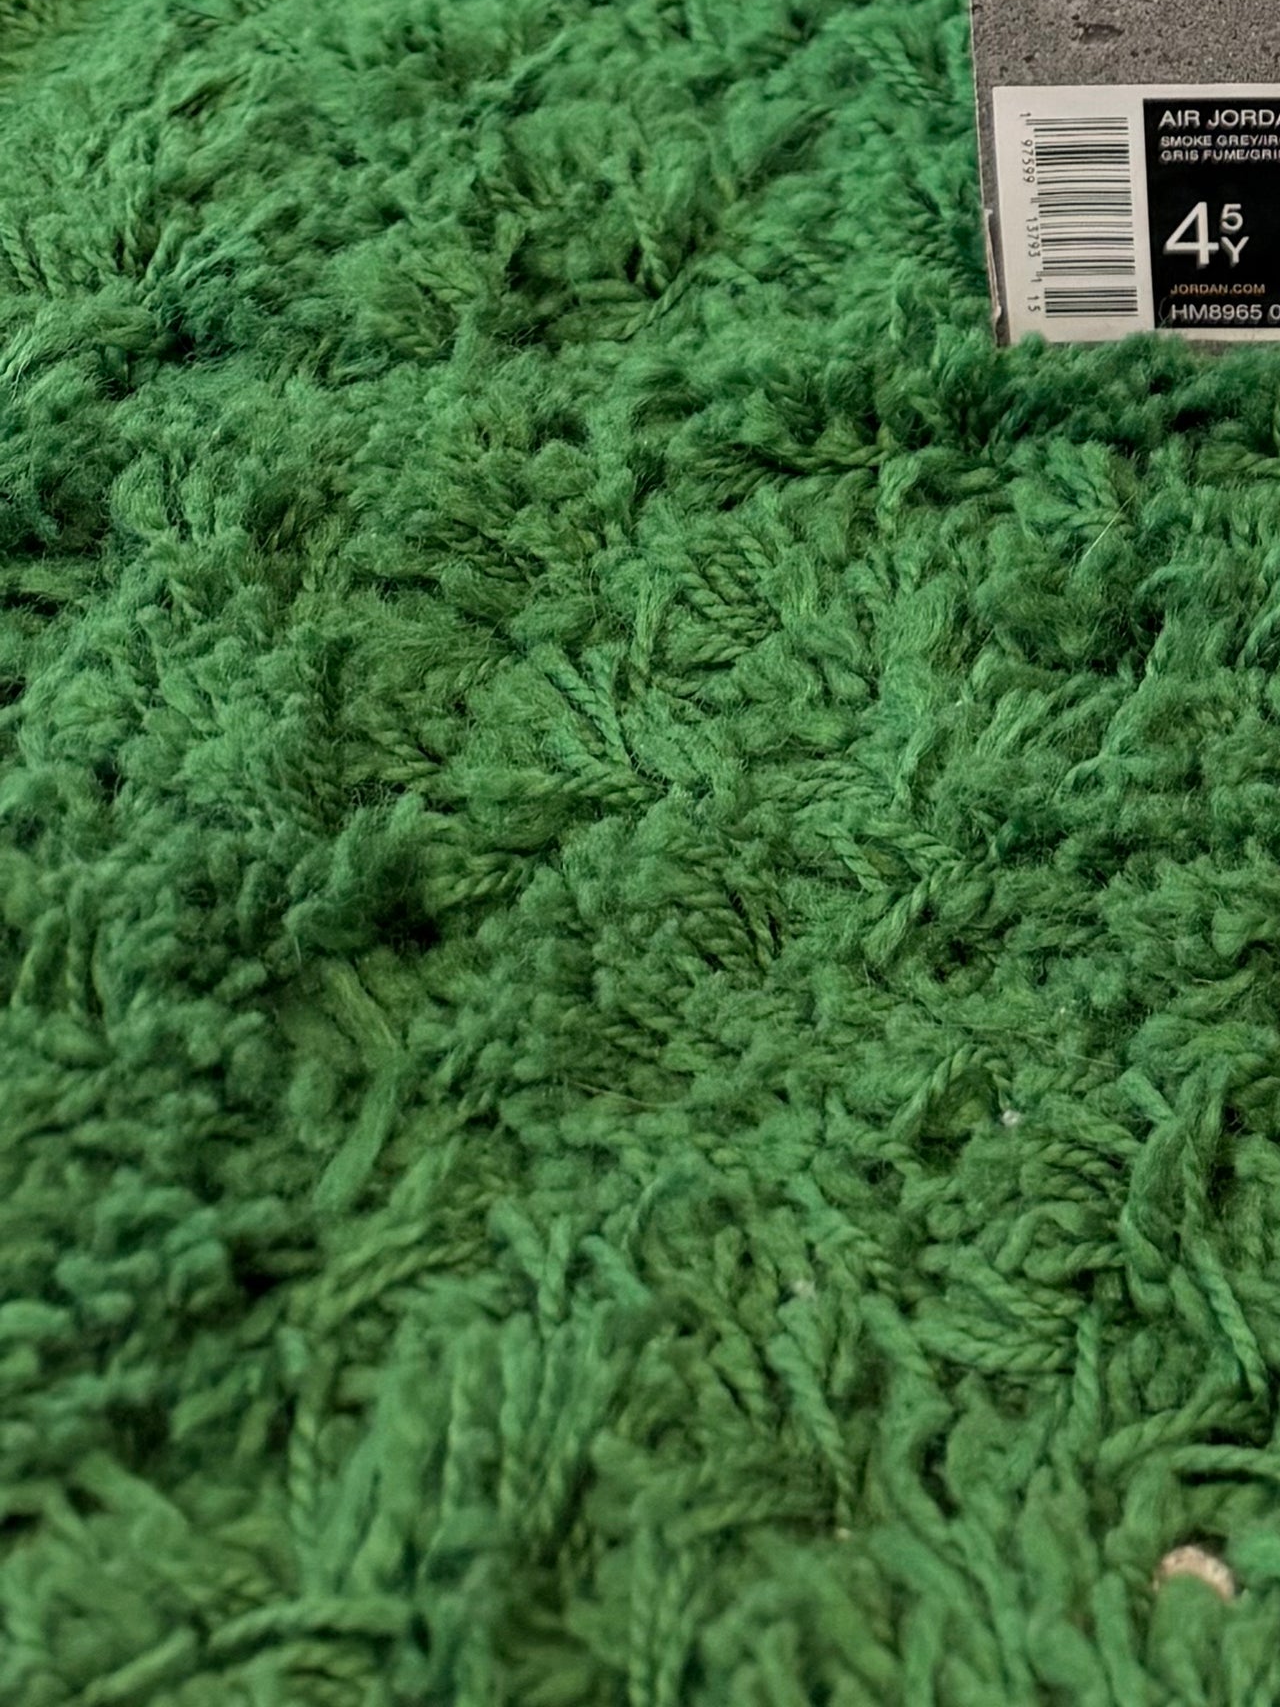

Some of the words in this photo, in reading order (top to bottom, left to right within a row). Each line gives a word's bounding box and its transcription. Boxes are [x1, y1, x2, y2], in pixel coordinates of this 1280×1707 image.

[1159, 109, 1200, 127] AIR
[1160, 135, 1212, 147] SMOKE
[1021, 139, 1035, 184] 97599
[1161, 150, 1199, 161] GRIS
[1221, 204, 1243, 233] 5
[1026, 217, 1041, 259] 13793
[1164, 201, 1219, 266] 4
[1221, 236, 1249, 264] Y
[1171, 284, 1266, 294] JORDAN.COM
[1027, 295, 1041, 312] 15
[1172, 304, 1262, 320] HM8965
